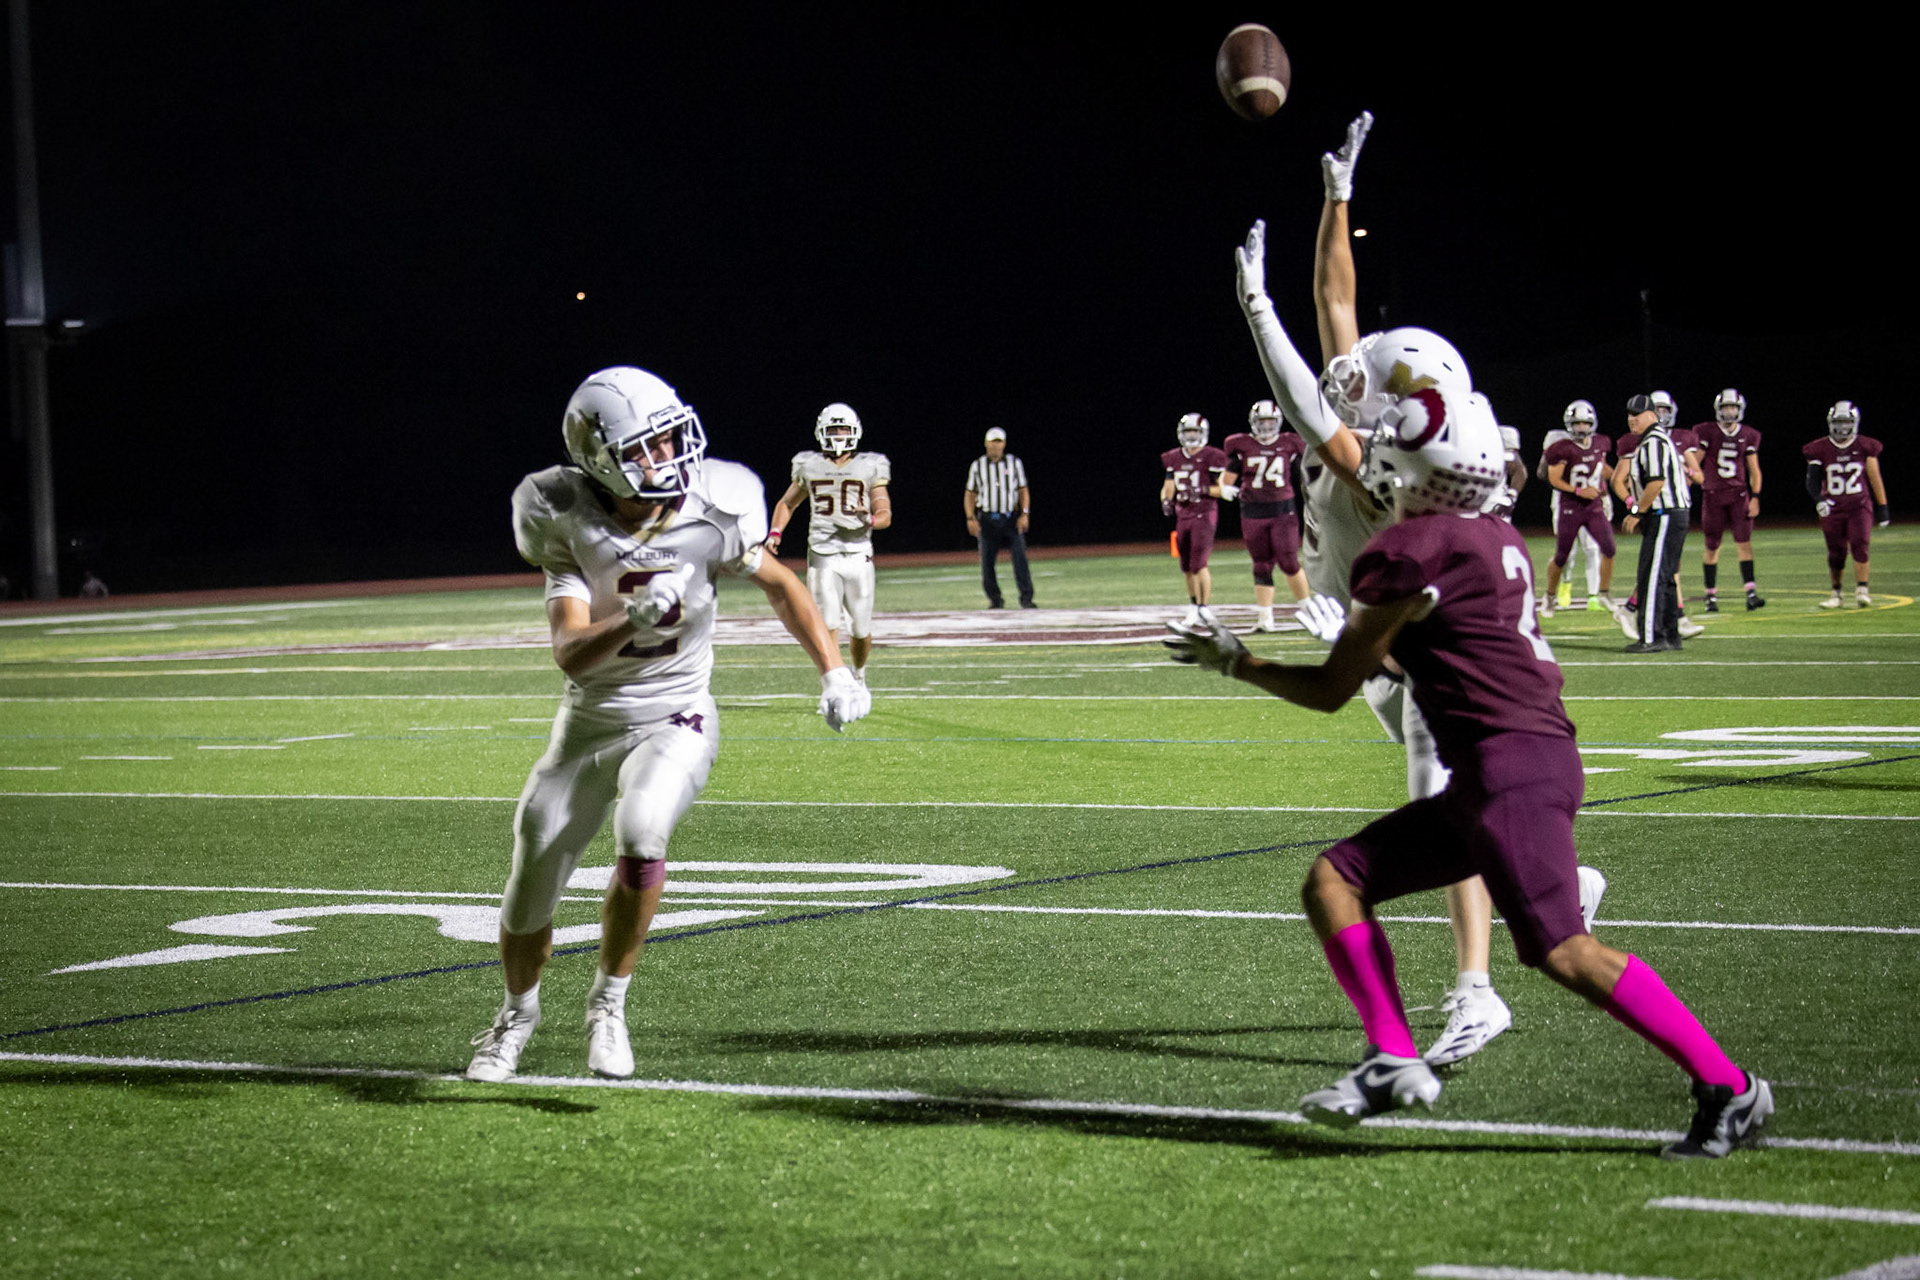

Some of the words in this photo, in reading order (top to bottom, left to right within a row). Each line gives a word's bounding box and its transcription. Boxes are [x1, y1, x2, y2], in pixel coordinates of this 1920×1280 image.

[1247, 456, 1286, 489] 74
[1570, 463, 1604, 489] 64
[1717, 449, 1738, 478] 5
[1826, 462, 1863, 495] 62
[810, 480, 865, 516] 50
[616, 551, 679, 561] MILLBURY
